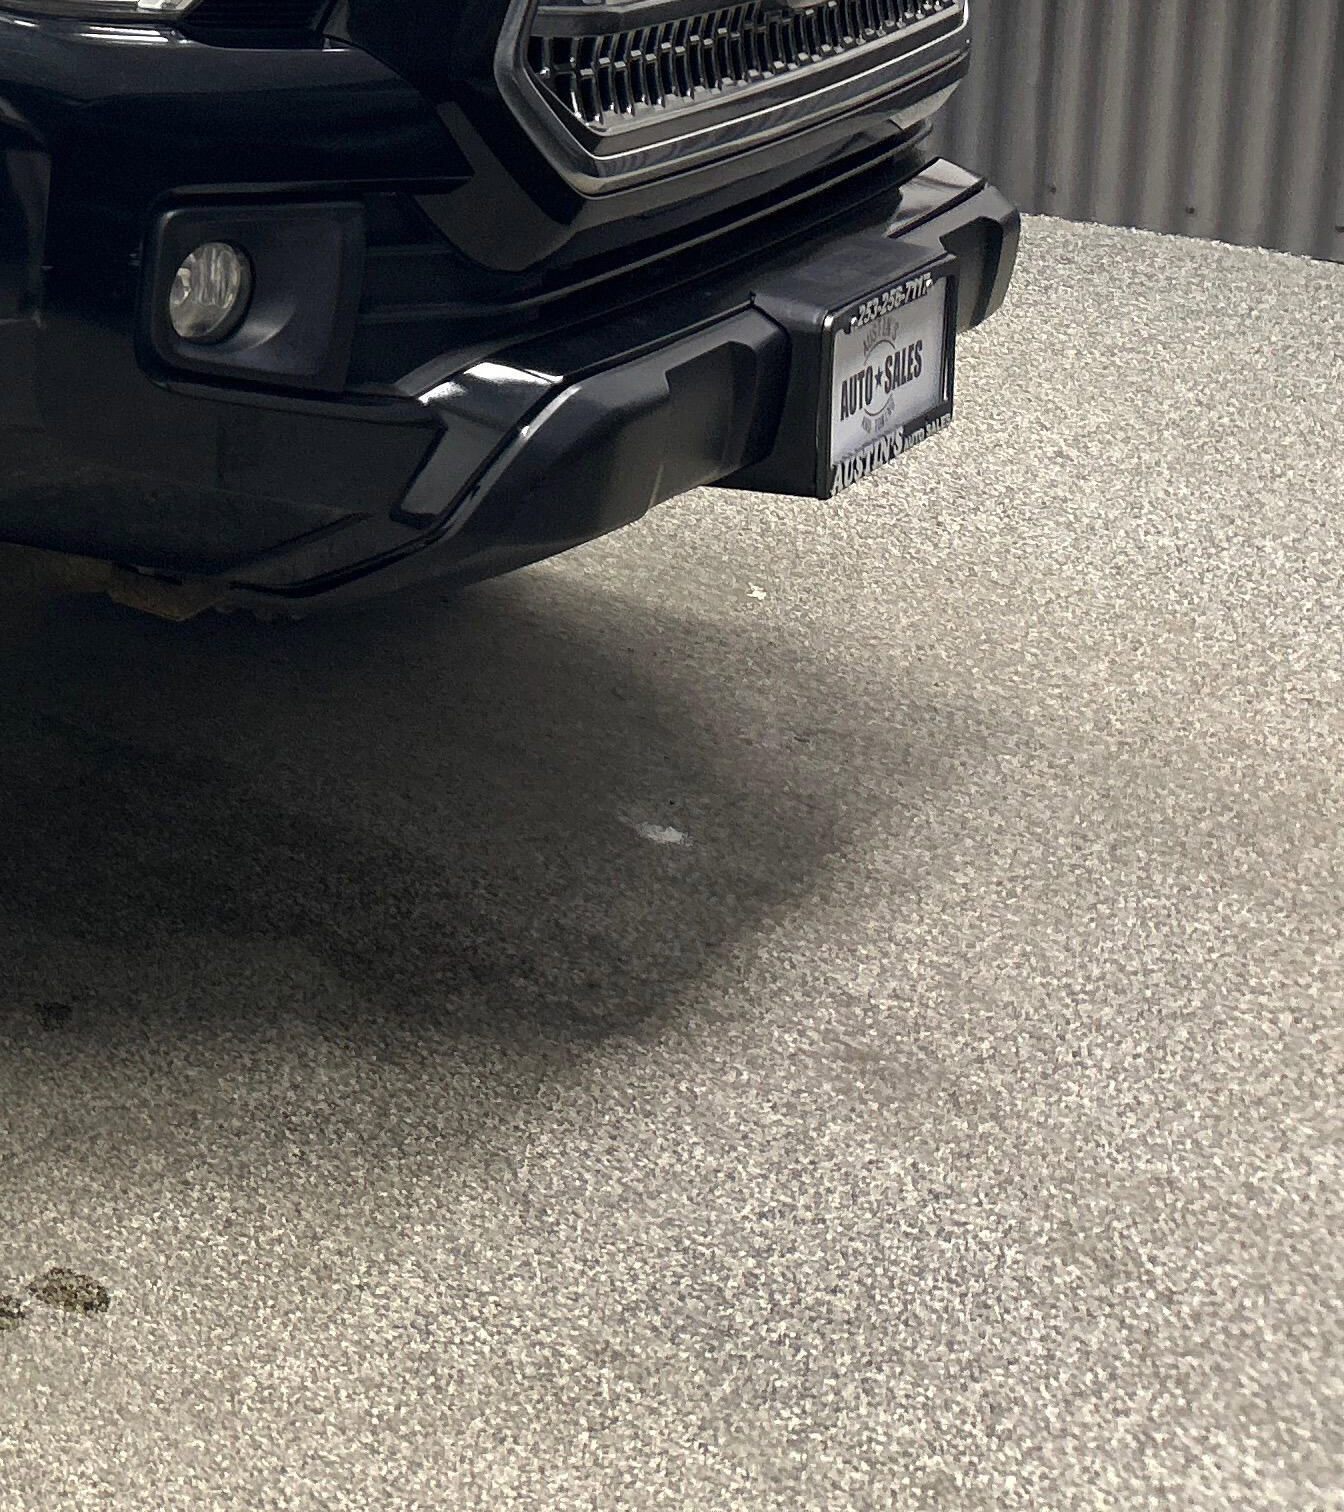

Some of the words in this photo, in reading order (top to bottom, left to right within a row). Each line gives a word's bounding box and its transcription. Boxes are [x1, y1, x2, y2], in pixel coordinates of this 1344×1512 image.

[840, 366, 874, 421] AUTO
[884, 339, 923, 395] SALES
[831, 425, 905, 496] AUSTIN'S
